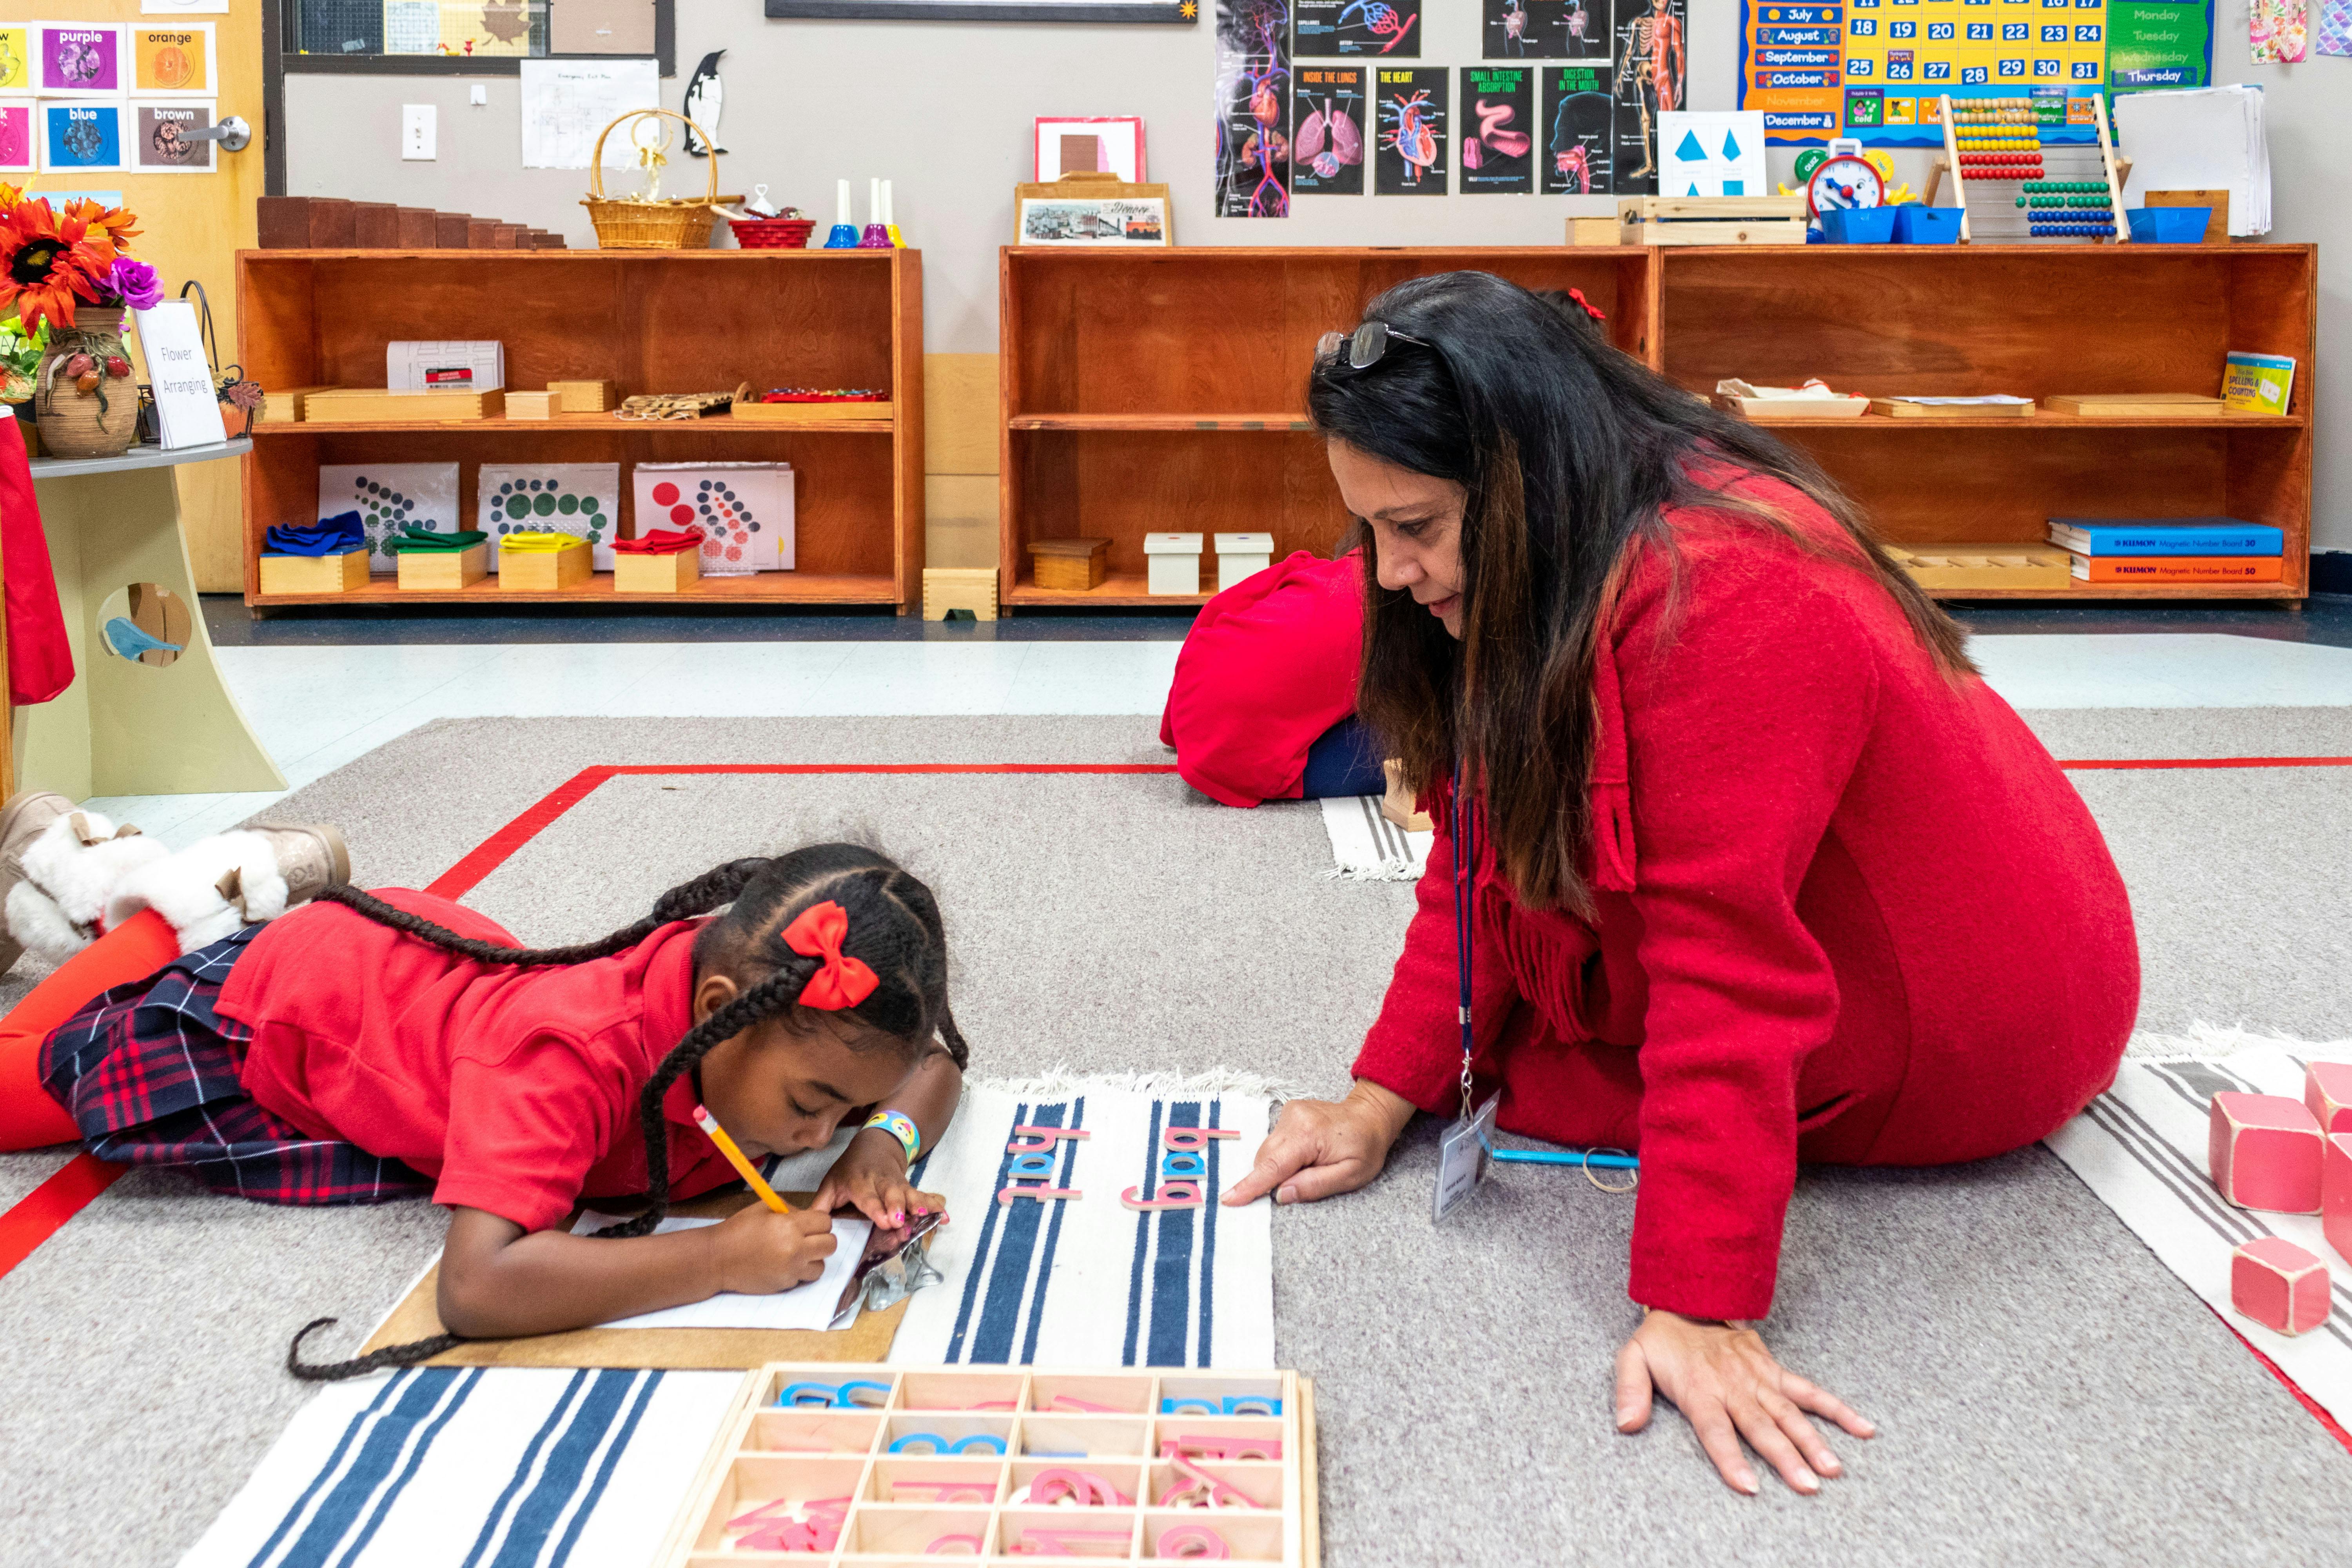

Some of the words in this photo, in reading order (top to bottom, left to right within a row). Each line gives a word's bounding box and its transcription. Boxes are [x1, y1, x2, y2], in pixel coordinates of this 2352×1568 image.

[1788, 9, 1813, 22] July
[2134, 9, 2180, 22] Monday
[1855, 21, 1873, 34] 18
[1895, 23, 1912, 37] 19
[1931, 24, 1952, 38] 20
[1971, 25, 1988, 38] 21
[2006, 25, 2025, 39] 22
[2045, 27, 2064, 41] 23
[2078, 27, 2098, 40] 24
[60, 31, 102, 44] purple
[149, 33, 191, 45] orange
[1777, 30, 1819, 45] August
[2133, 30, 2179, 43] Tuesday
[1765, 51, 1829, 65] September
[2122, 51, 2188, 64] Wednesday
[1850, 60, 1870, 74] 25
[1890, 64, 1910, 78] 26
[1928, 64, 1948, 78] 27
[2002, 61, 2022, 75] 29
[2037, 61, 2058, 75] 30
[2076, 64, 2092, 78] 31
[1303, 72, 1323, 83] INSIDE
[1325, 72, 1335, 83] THE
[1337, 72, 1357, 83] LUNGS
[1380, 71, 1391, 83] THE
[1393, 71, 1413, 83] HEART
[1471, 71, 1490, 82] SMALL
[1492, 71, 1523, 82] INTESTINE
[1563, 69, 1594, 80] DIGESTION
[1773, 73, 1822, 84] October
[1965, 68, 1985, 83] 28
[2128, 69, 2181, 83] Thursday
[1478, 82, 1515, 93] ABSORPTION
[1559, 80, 1565, 91] IN
[1566, 80, 1577, 91] THE
[1578, 80, 1599, 91] MOUTH
[1766, 95, 1825, 105] November
[69, 108, 97, 120] blue
[154, 108, 194, 120] brown
[1765, 114, 1822, 126] December
[1855, 114, 1873, 123] cold
[1804, 156, 1819, 172] QUIZ
[1111, 201, 1150, 214] Denver
[162, 347, 192, 361] Flower
[164, 378, 207, 394] Arranging
[2160, 540, 2190, 548] Magnetic
[2160, 567, 2190, 575] Magnetic
